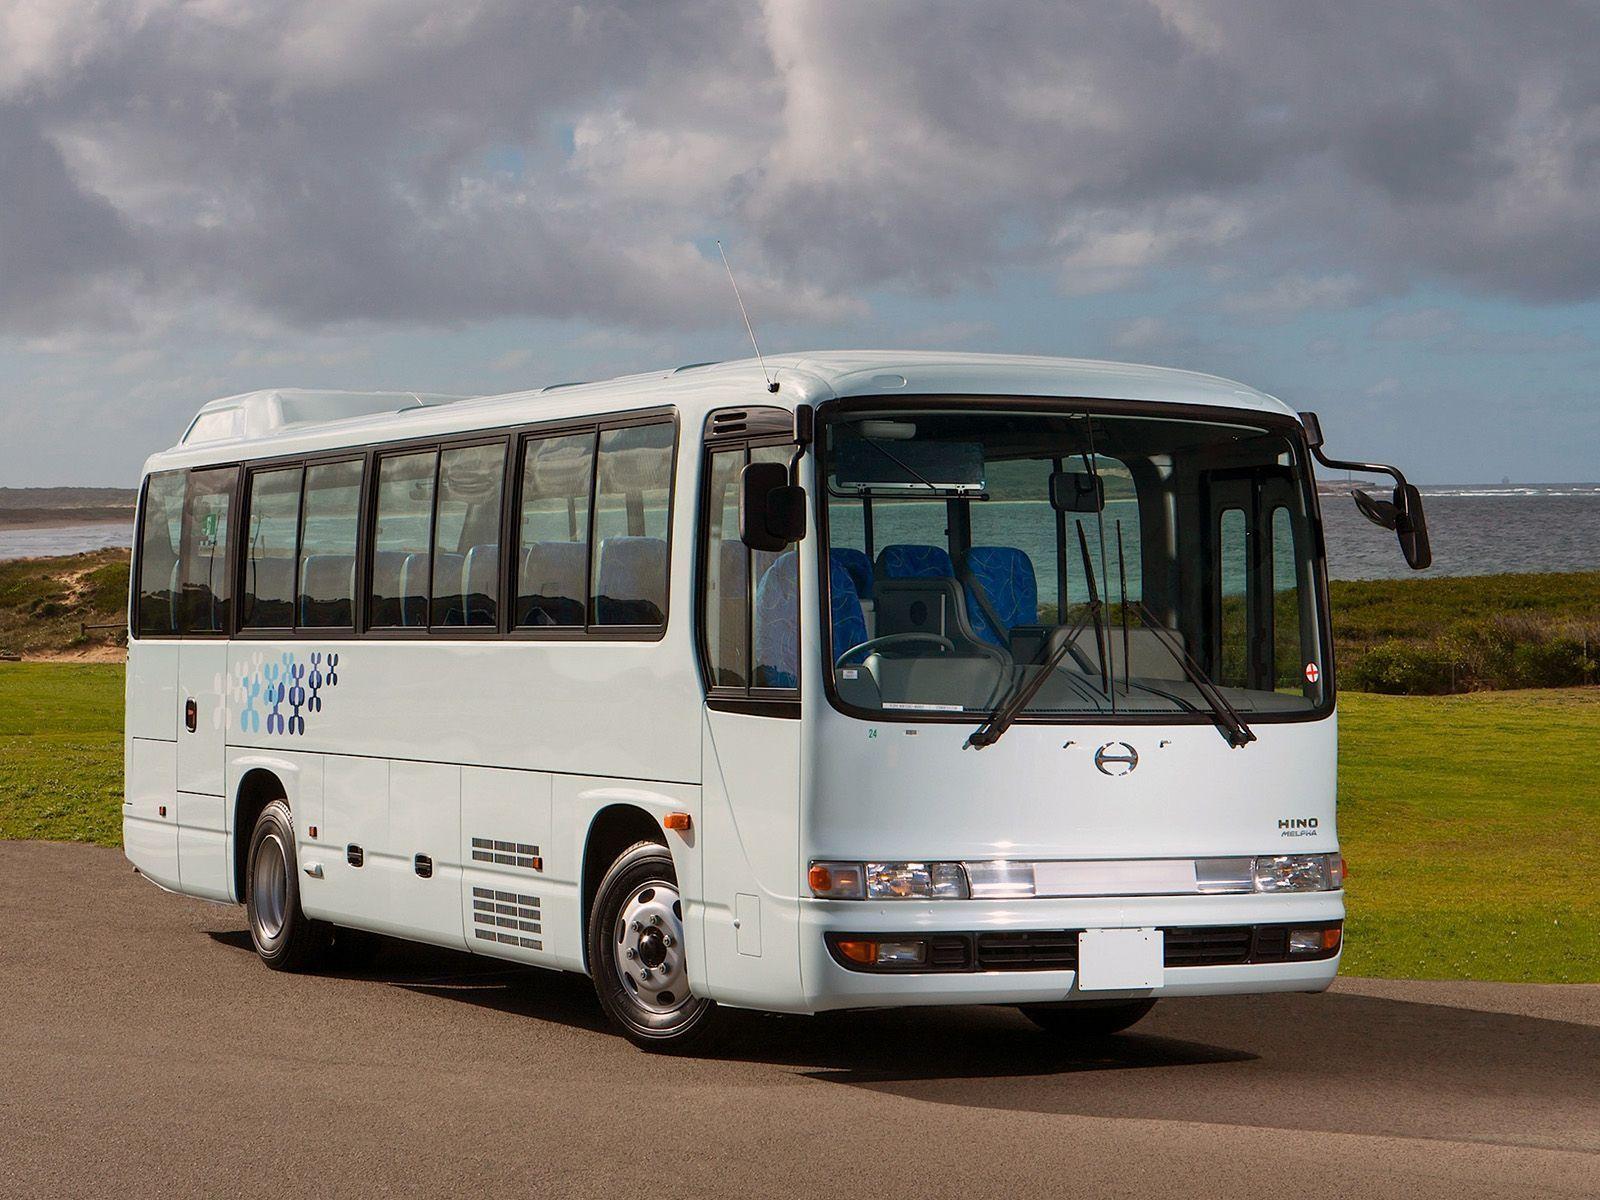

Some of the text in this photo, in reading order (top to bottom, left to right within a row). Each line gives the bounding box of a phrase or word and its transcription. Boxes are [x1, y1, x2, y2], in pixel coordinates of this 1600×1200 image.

[868, 728, 877, 739] 24
[1278, 817, 1319, 829] HINO
[1281, 829, 1318, 837] MELPHA
